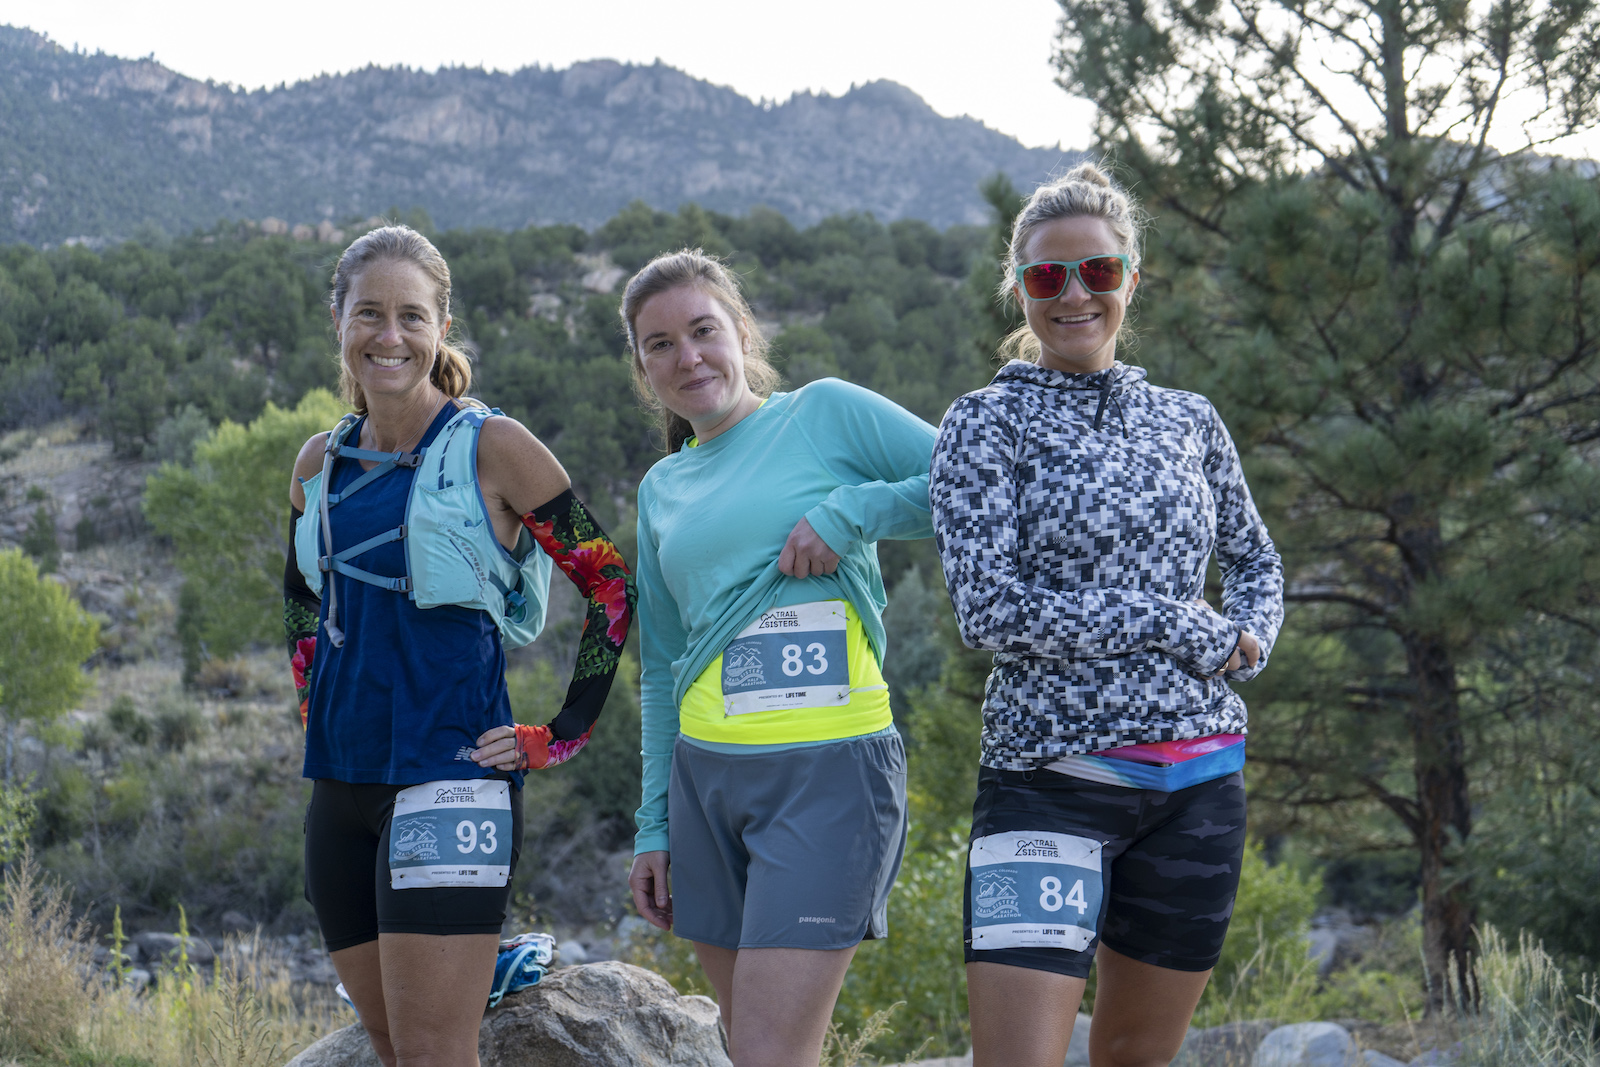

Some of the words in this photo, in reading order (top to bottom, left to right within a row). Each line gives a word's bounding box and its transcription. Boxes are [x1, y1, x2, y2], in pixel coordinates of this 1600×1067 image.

[781, 642, 829, 677] 83
[740, 669, 764, 678] SISTERS
[455, 820, 498, 855] 93
[1034, 839, 1058, 847] TRAIL
[412, 843, 438, 853] SISTERS
[1039, 875, 1088, 915] 84
[992, 900, 1019, 909] SISTERS
[798, 916, 836, 924] patagonia
